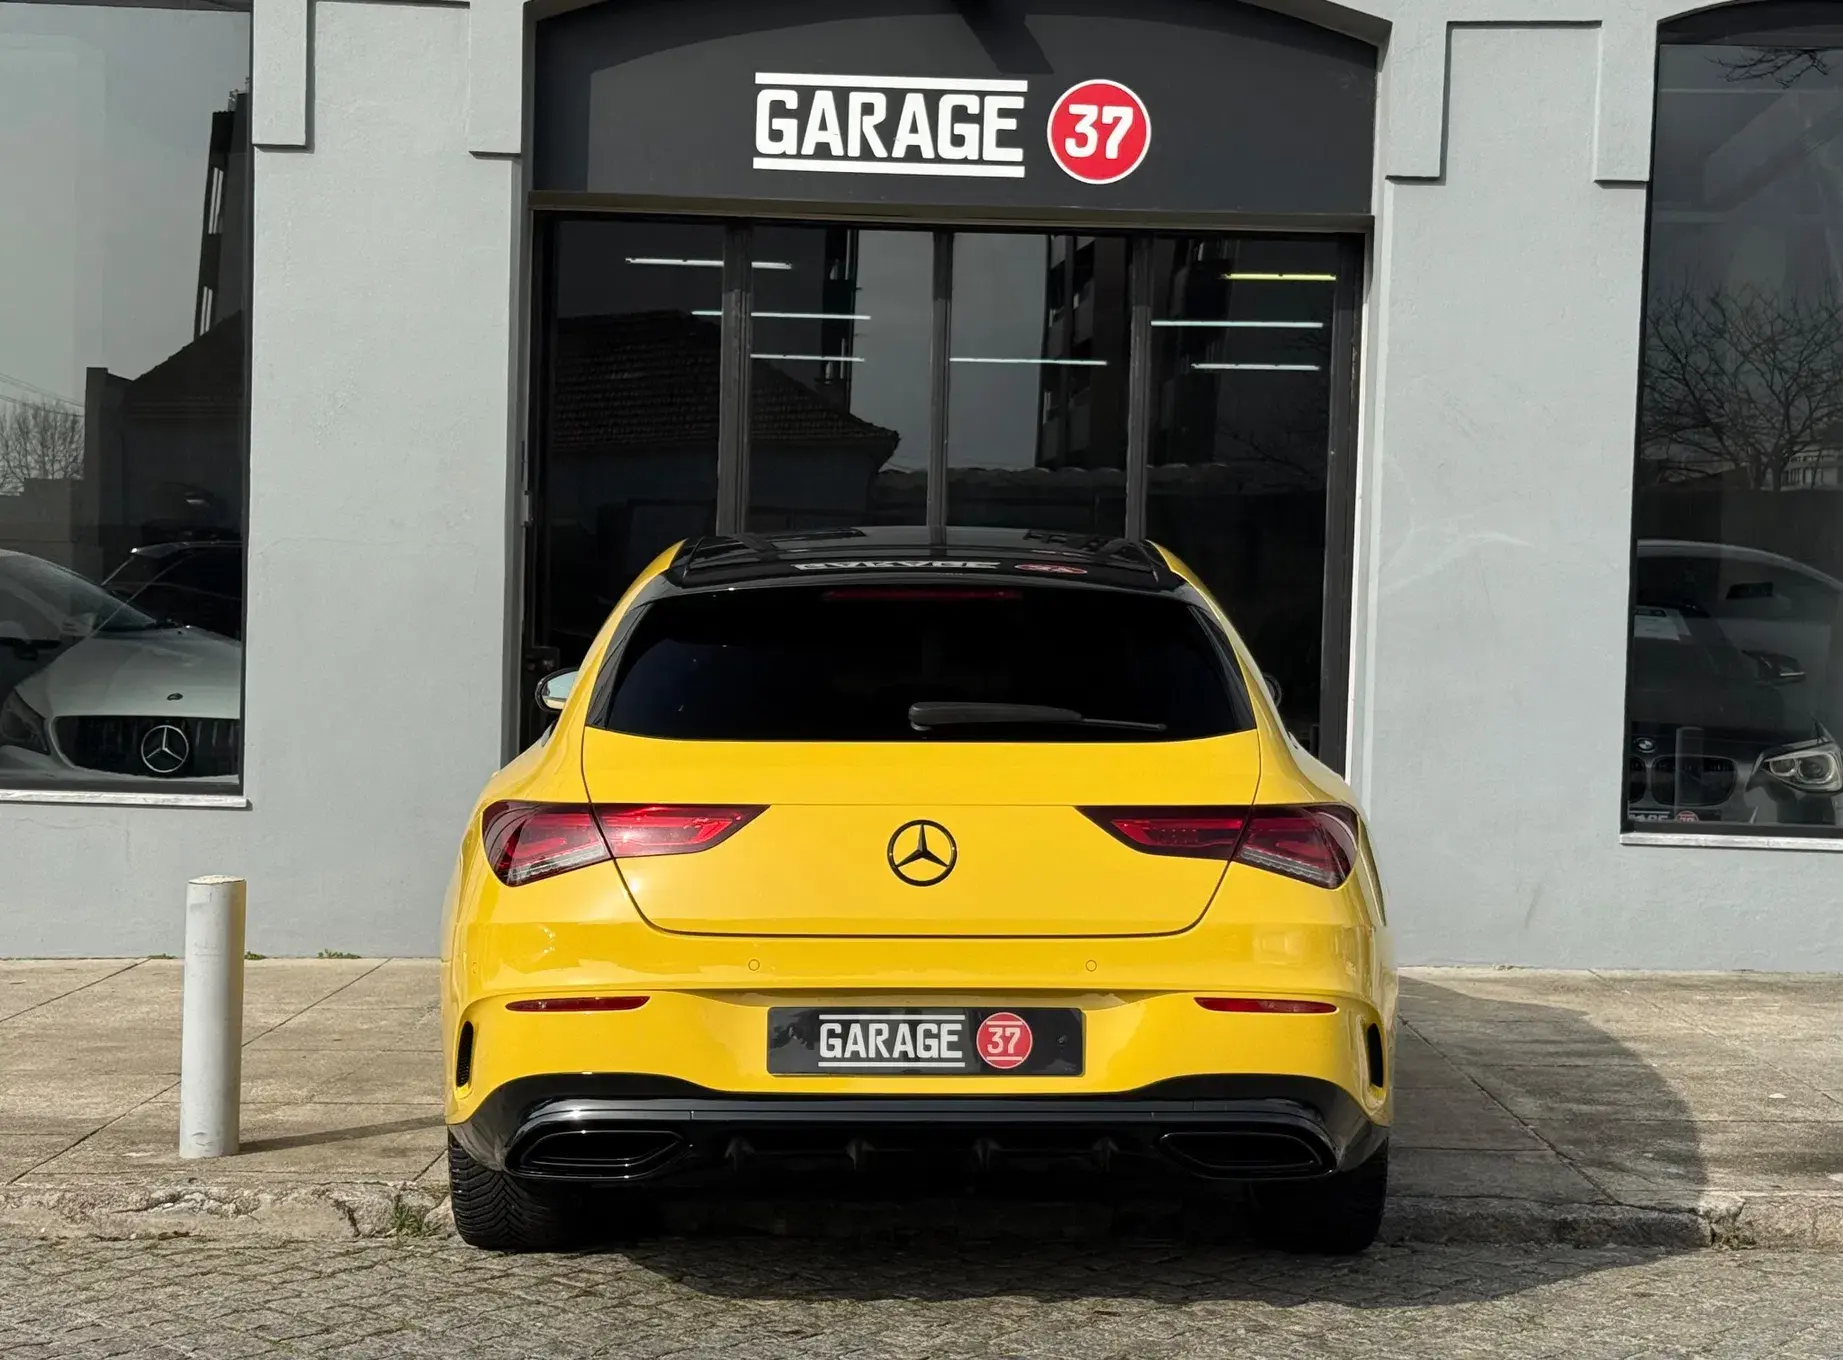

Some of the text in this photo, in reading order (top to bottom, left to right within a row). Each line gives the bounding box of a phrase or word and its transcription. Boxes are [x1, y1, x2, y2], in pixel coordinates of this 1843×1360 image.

[756, 89, 1134, 162] GARAGE 37
[820, 1023, 1022, 1059] GARAGE 37
